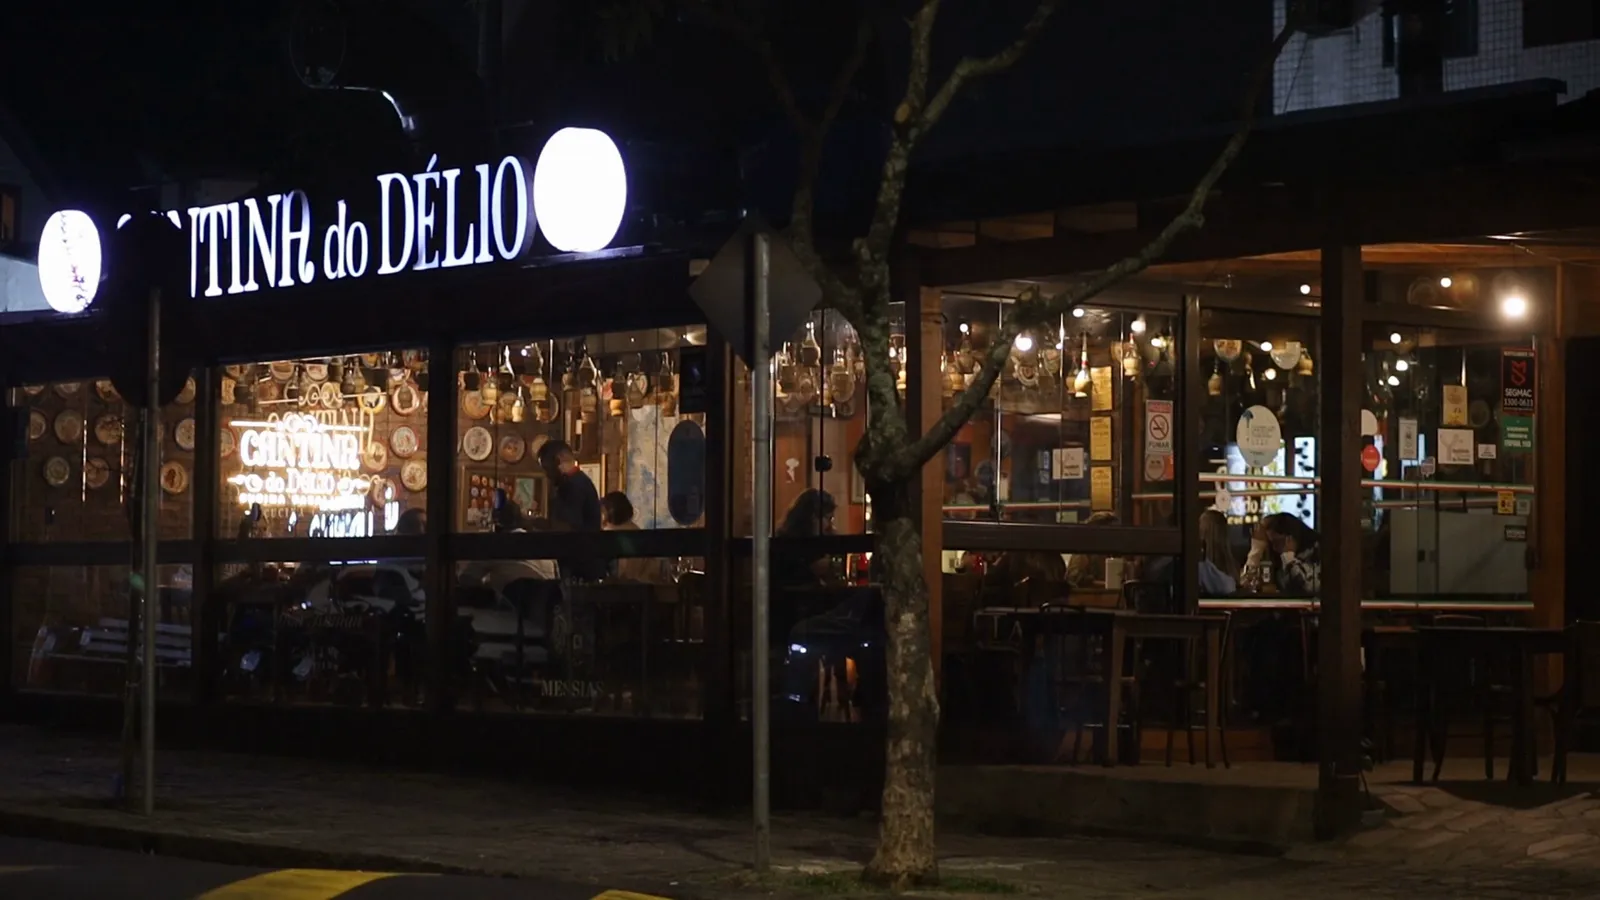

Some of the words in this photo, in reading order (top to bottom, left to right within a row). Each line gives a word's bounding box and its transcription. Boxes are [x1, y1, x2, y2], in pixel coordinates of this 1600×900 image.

[117, 189, 316, 299] NTINA
[323, 199, 369, 281] do
[376, 153, 528, 275] DÉLIO
[240, 429, 360, 470] CANTINA
[1148, 441, 1170, 449] FUMAR
[265, 471, 285, 493] do
[541, 678, 604, 697] MESSIAS
